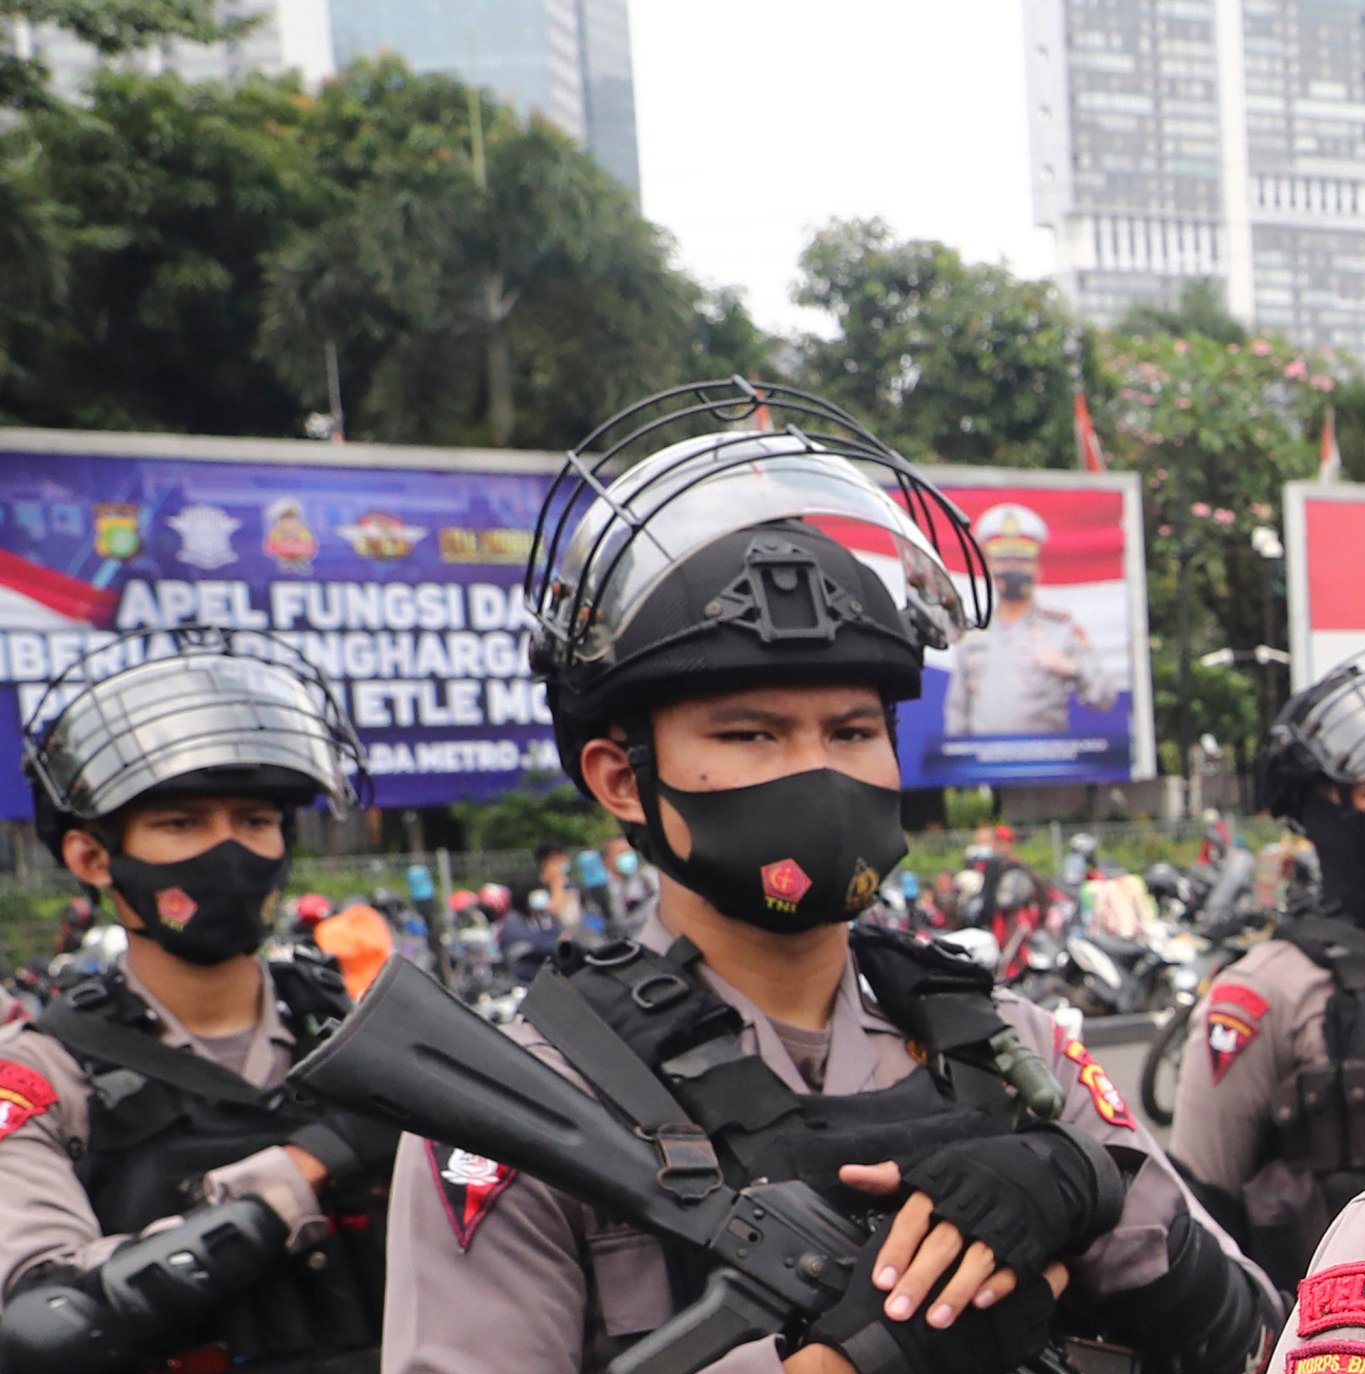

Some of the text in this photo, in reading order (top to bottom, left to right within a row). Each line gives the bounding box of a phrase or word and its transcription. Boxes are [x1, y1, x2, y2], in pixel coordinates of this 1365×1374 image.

[116, 579, 269, 630] APEL
[270, 581, 466, 631] FUNGSI
[352, 679, 484, 727] ETLE
[415, 740, 520, 774] METRO
